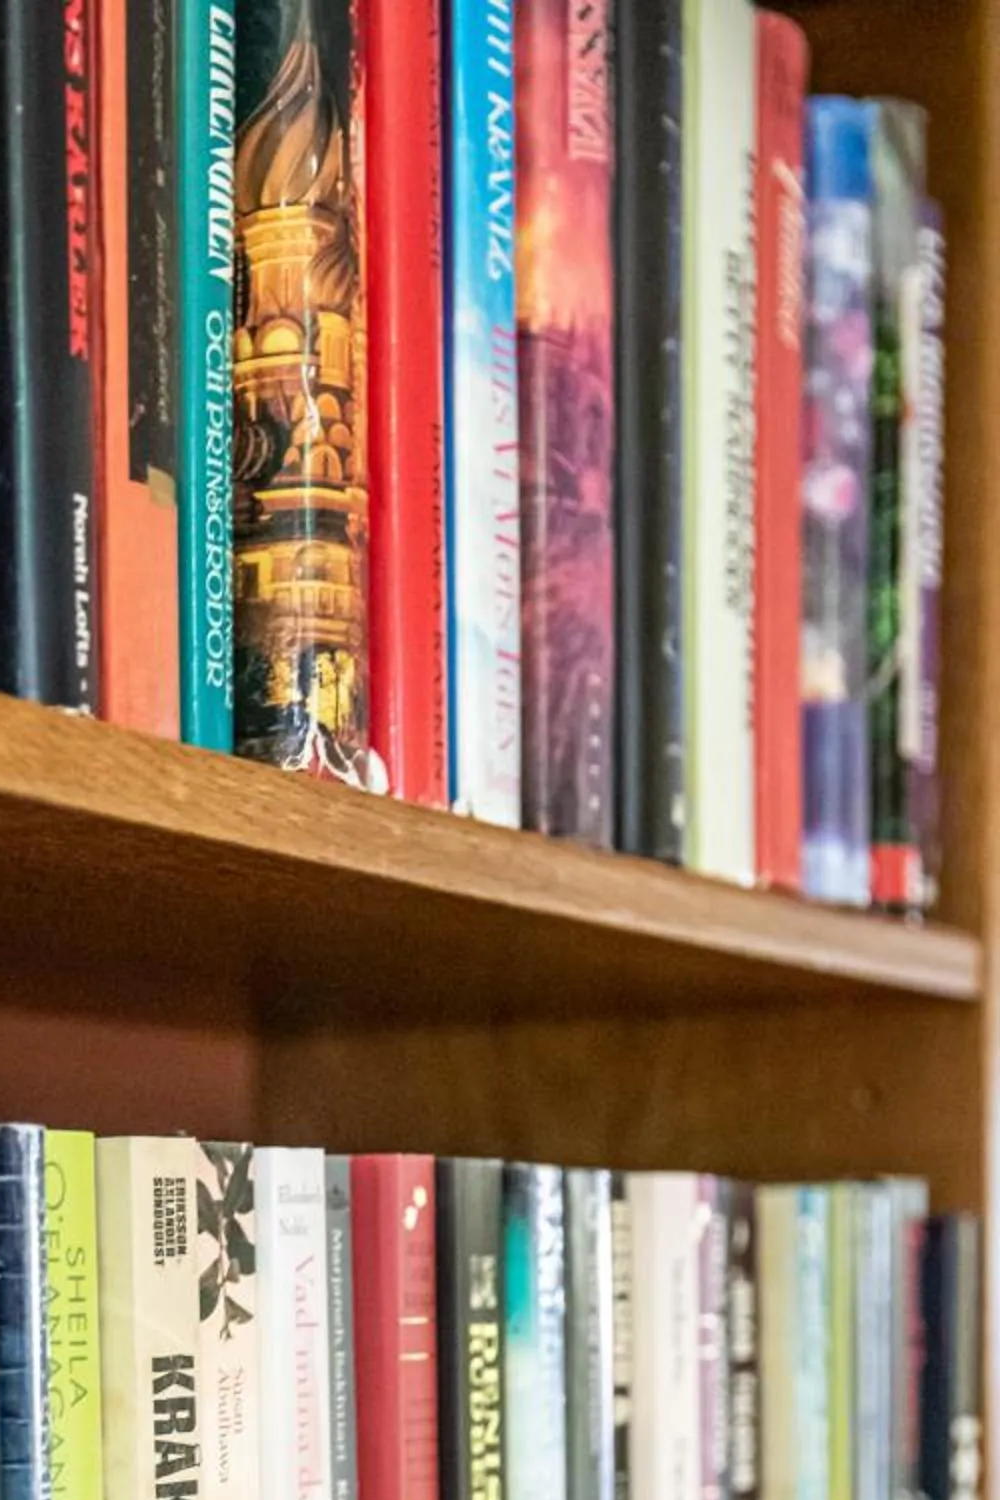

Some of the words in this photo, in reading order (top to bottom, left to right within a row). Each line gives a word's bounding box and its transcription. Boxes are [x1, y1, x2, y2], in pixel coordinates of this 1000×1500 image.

[205, 309, 227, 392] OCH
[72, 493, 90, 584] Norah
[205, 400, 228, 691] PRINSGRODOR
[75, 590, 92, 669] Lofts
[152, 1177, 166, 1267] SUNDQUIST
[65, 1246, 90, 1409] SHEILA
[294, 1252, 320, 1330] Vad
[217, 1368, 232, 1484] Abulhawa
[232, 1366, 247, 1435] Susan
[294, 1348, 316, 1454] mina
